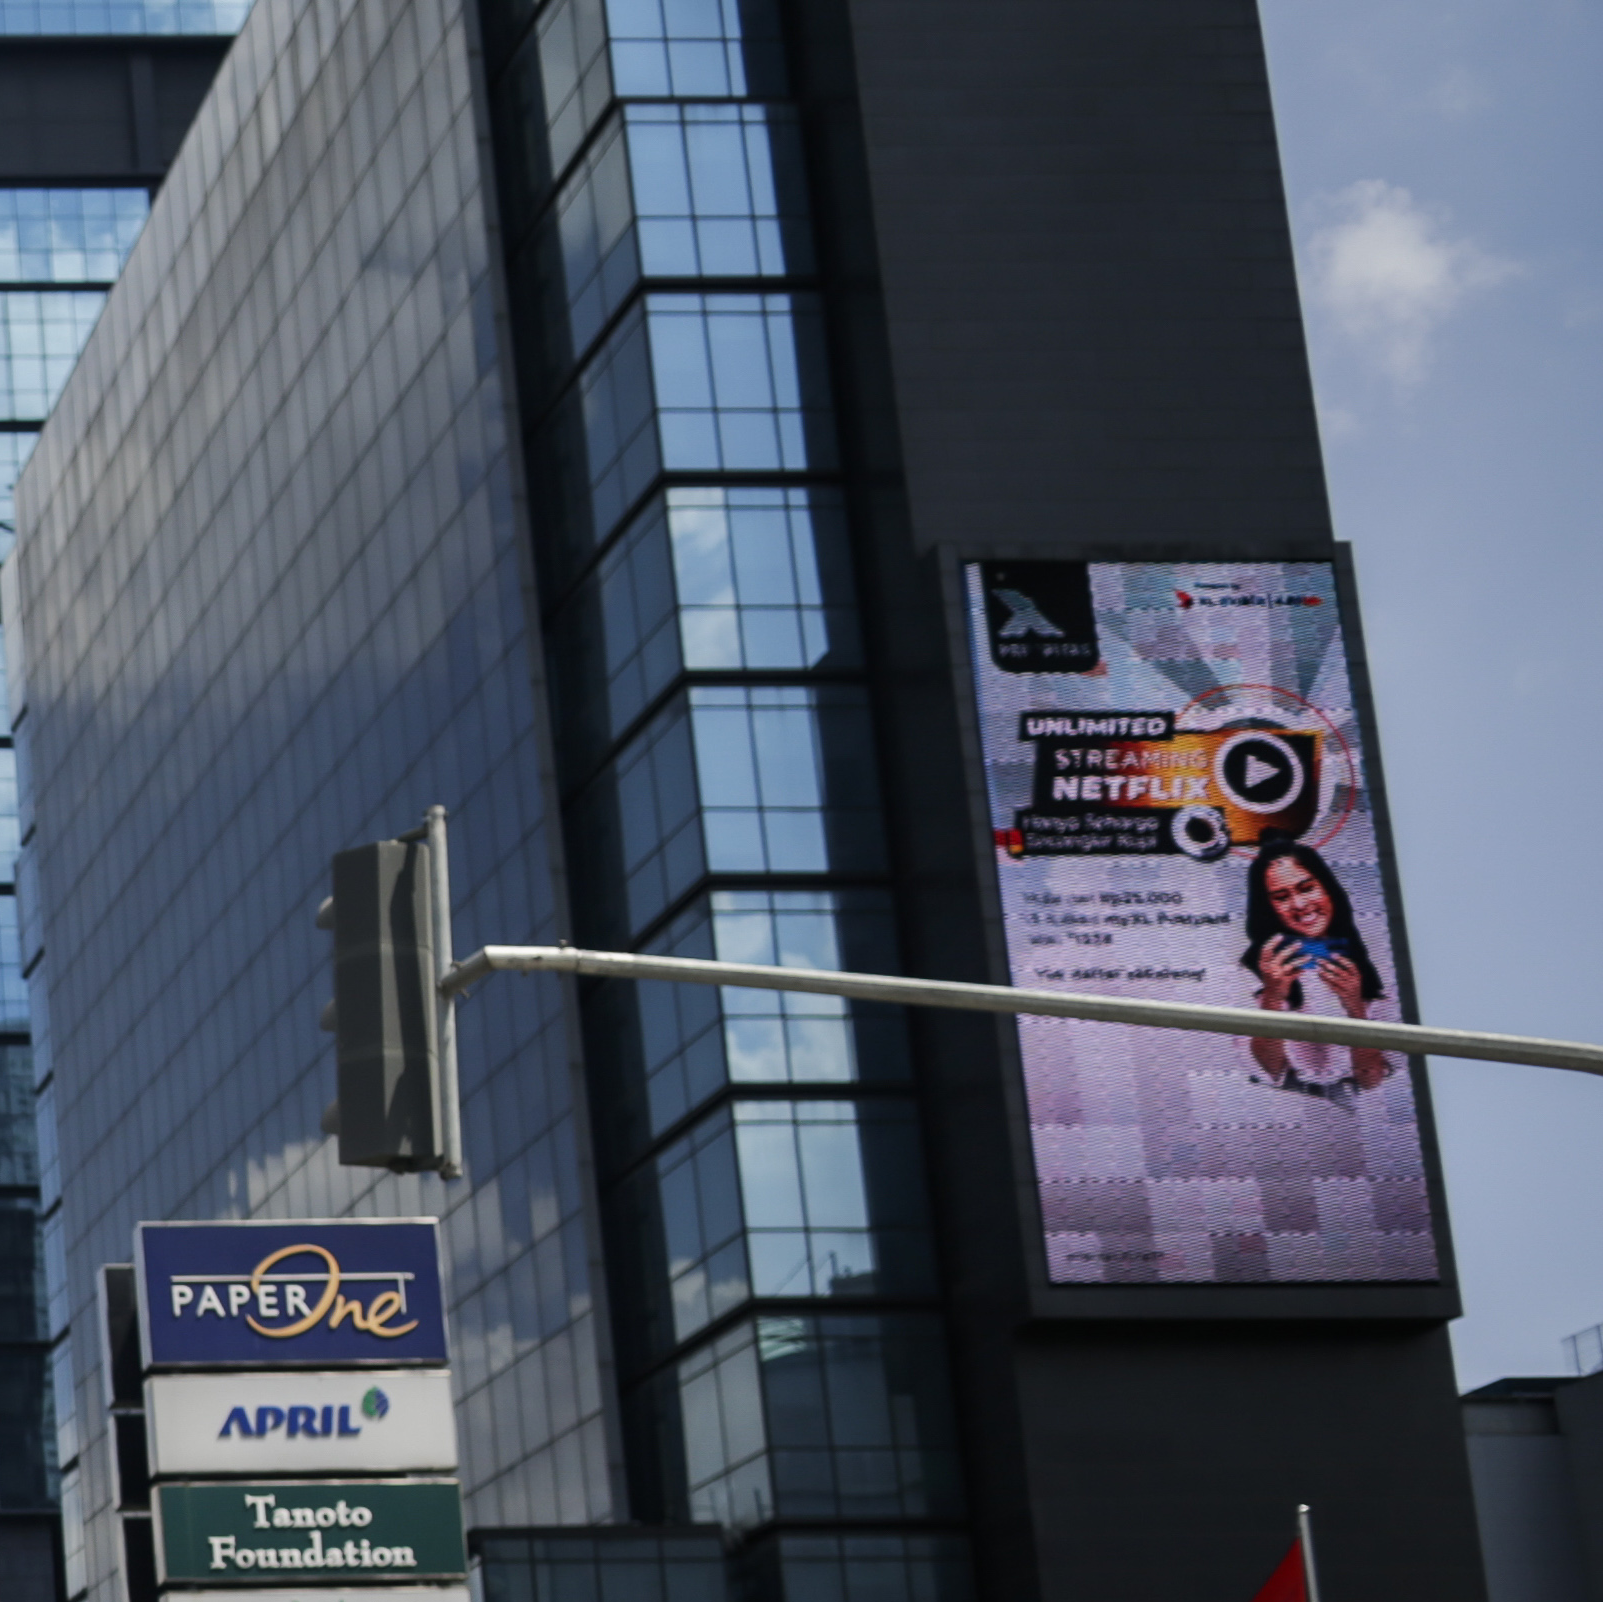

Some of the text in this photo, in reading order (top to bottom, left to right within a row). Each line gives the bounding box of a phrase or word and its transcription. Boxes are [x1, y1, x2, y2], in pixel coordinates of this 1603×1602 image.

[1026, 716, 1167, 737] UNLIMITED
[1054, 748, 1208, 771] STREAMING
[1052, 775, 1210, 801] NETFLIX
[171, 1243, 420, 1338] PAPER One
[217, 1404, 362, 1439] APRIL
[244, 1493, 373, 1529] Tanoto
[207, 1529, 418, 1570] Foundation
